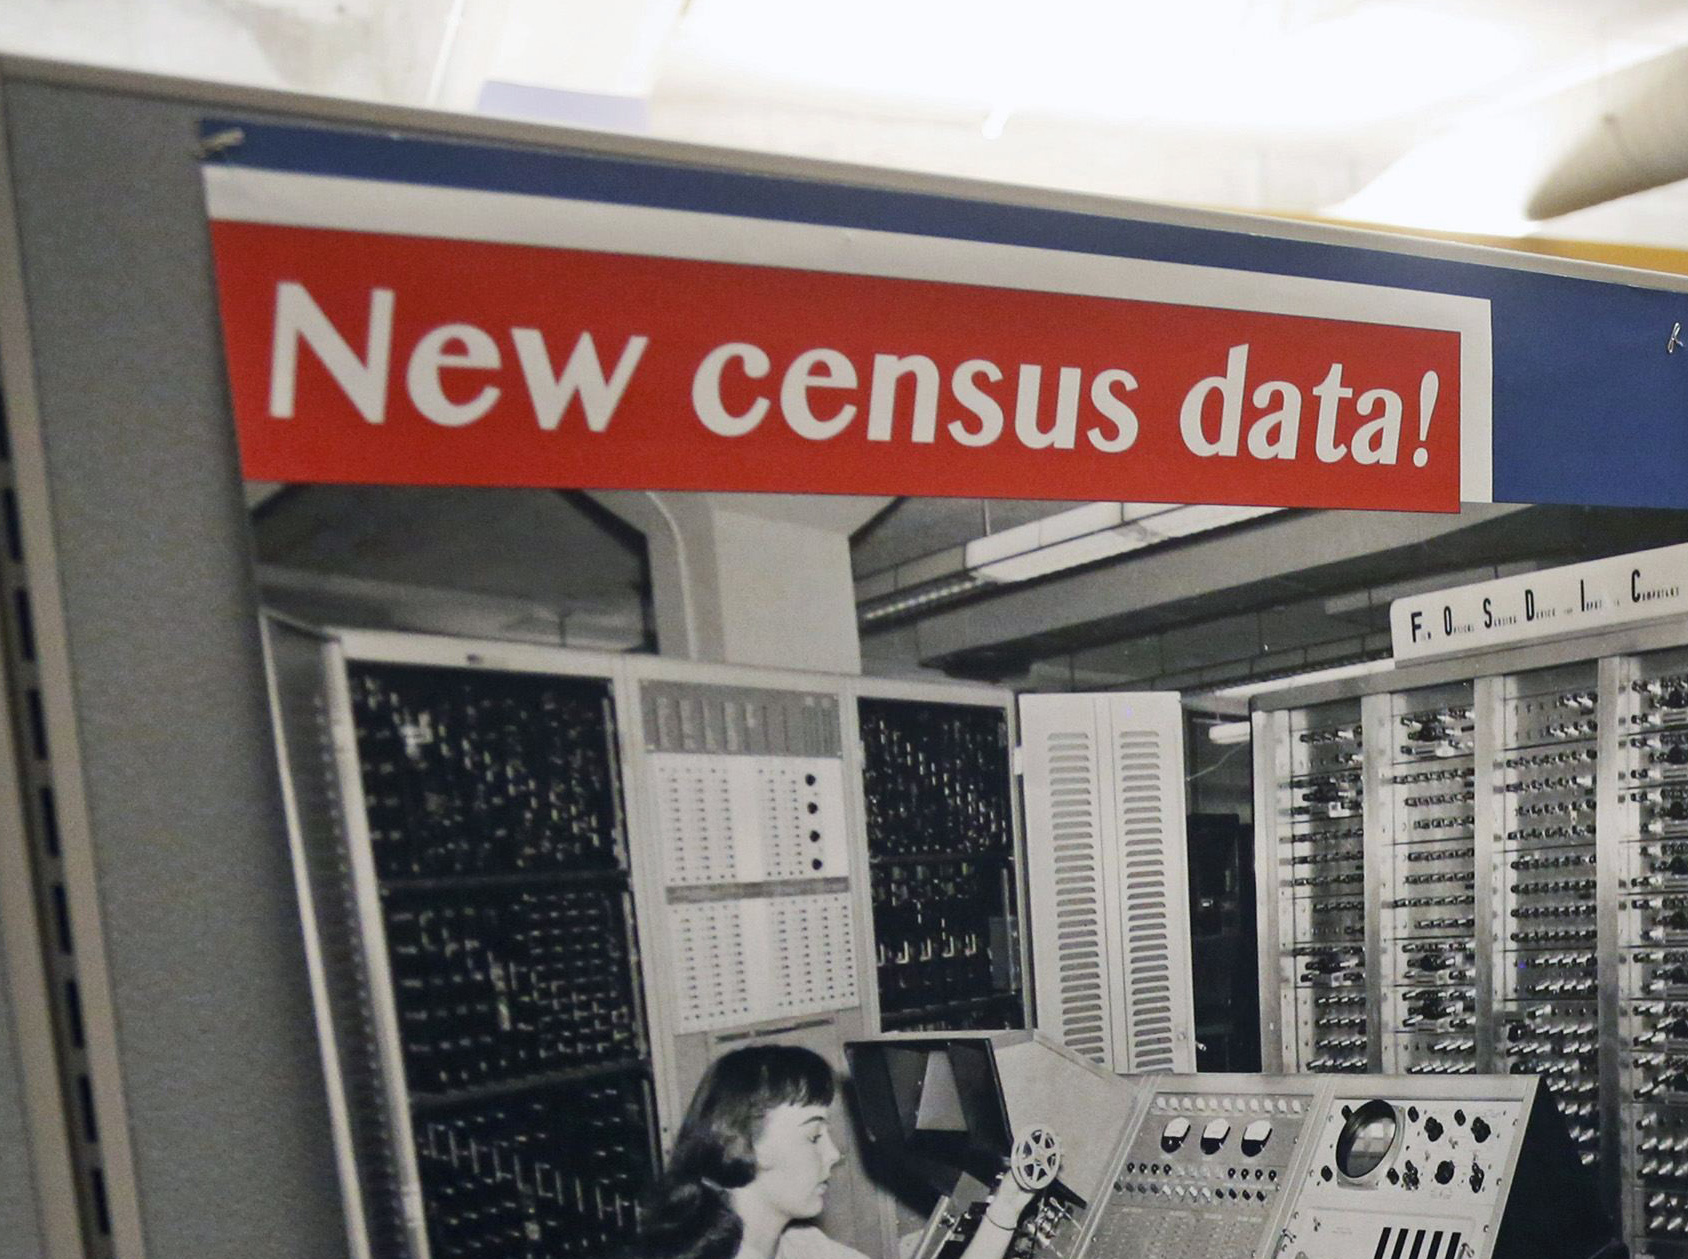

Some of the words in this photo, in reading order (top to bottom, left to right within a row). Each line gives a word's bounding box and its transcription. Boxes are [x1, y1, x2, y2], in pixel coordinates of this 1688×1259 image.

[268, 281, 649, 433] New
[691, 342, 1139, 453] census
[1179, 343, 1439, 468] data!
